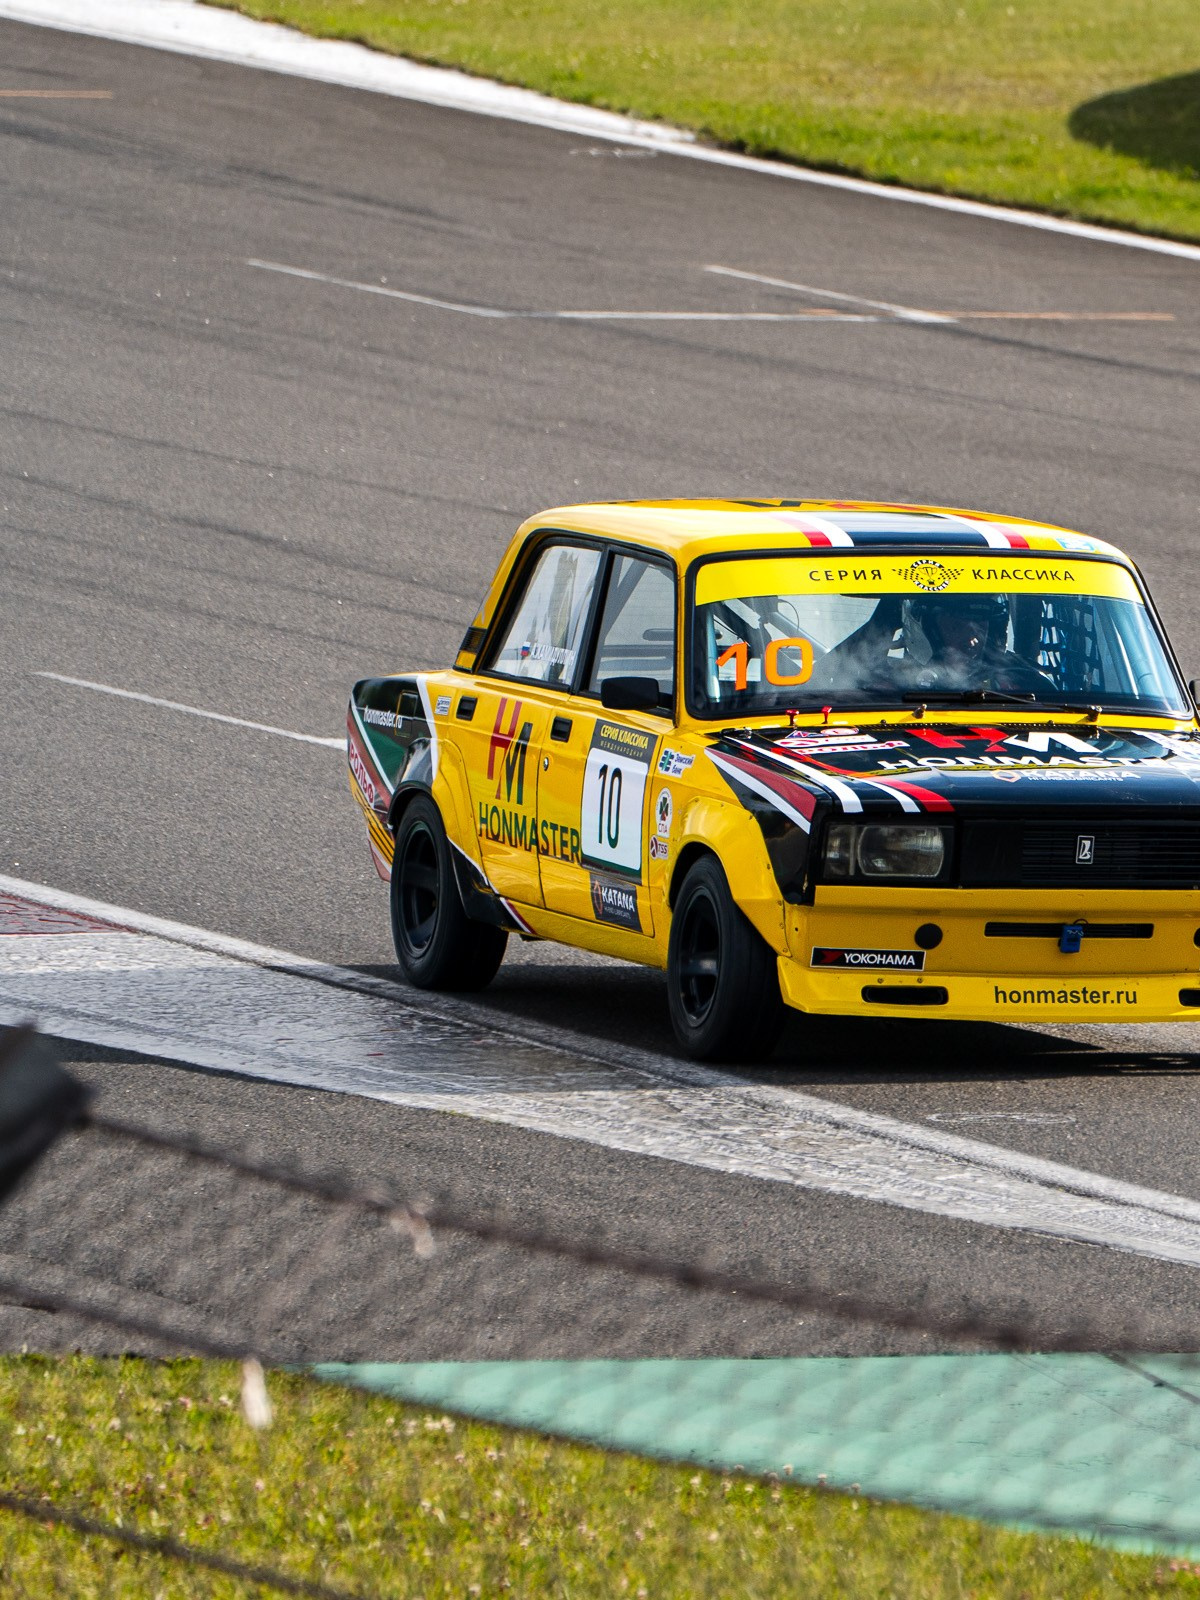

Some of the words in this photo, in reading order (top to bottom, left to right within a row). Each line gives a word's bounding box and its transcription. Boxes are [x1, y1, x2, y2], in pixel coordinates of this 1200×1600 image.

[809, 569, 883, 581] СЕРИЯ
[972, 569, 1076, 582] КЛАССИКА
[715, 637, 814, 691] 10
[600, 724, 619, 741] СЕРИЯ
[617, 729, 649, 750] КЛАССИКА
[1020, 770, 1141, 779] KATANA
[598, 763, 622, 849] 10
[478, 801, 581, 865] HONMASTER
[601, 886, 635, 912] KATANA
[844, 952, 916, 966] YOKOHAMA
[994, 986, 1138, 1005] honmaster.ru
